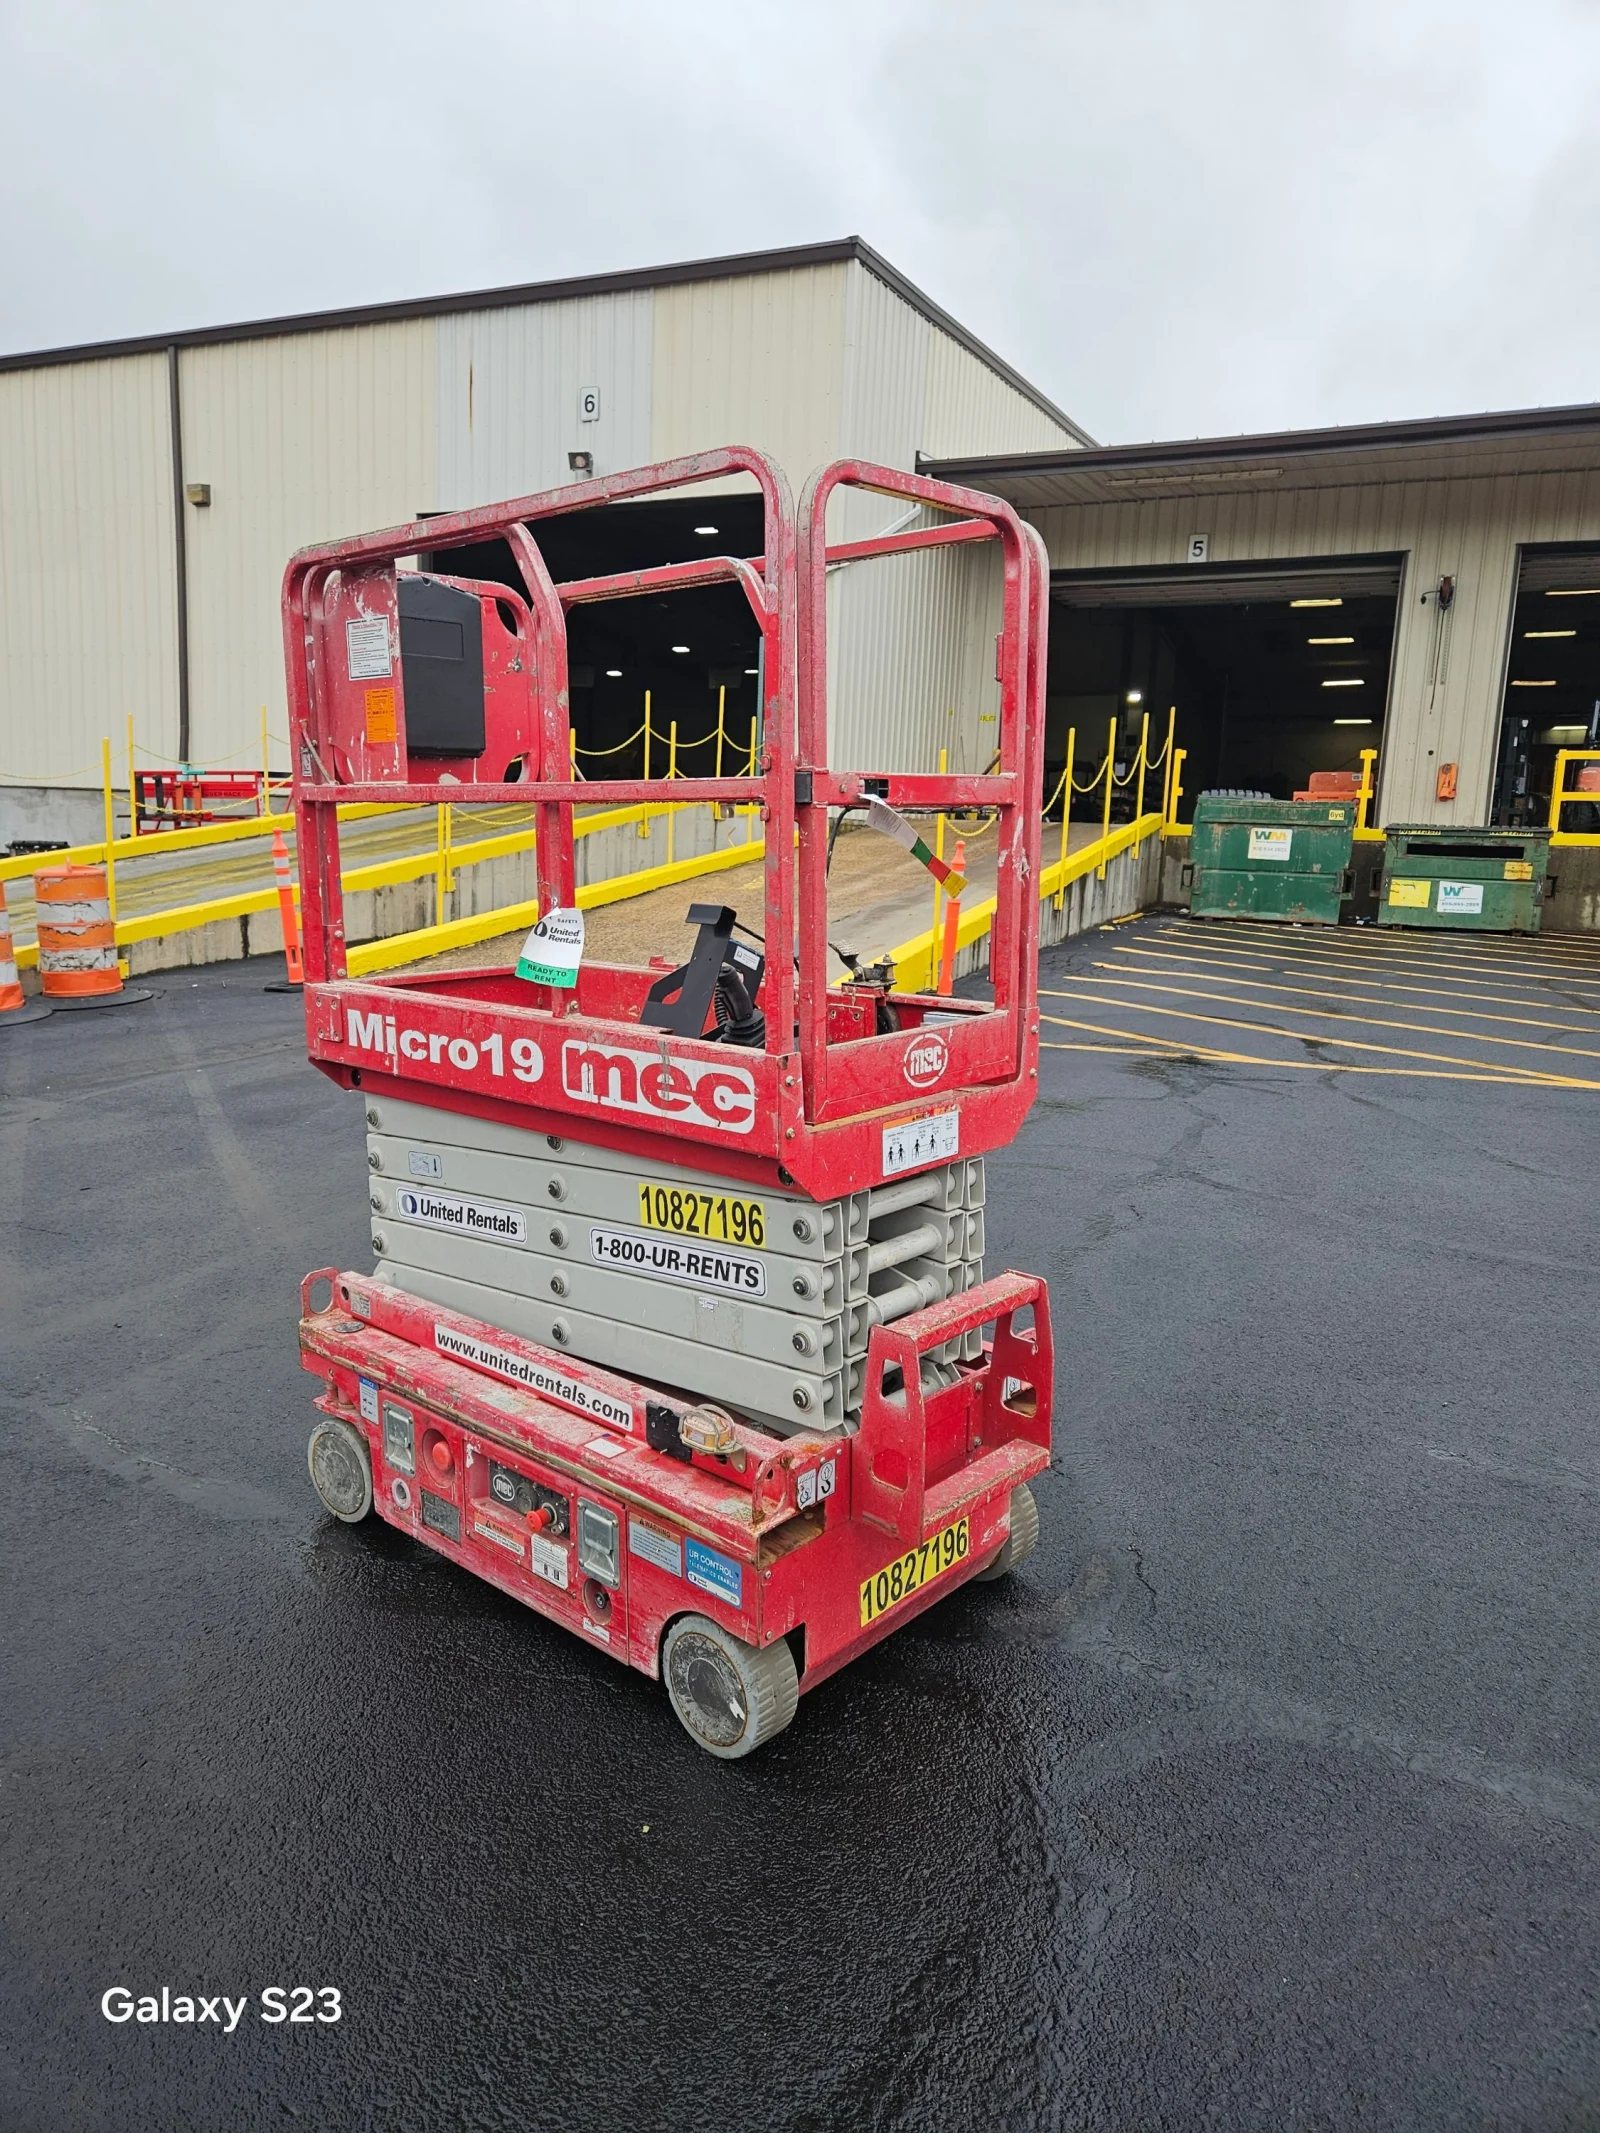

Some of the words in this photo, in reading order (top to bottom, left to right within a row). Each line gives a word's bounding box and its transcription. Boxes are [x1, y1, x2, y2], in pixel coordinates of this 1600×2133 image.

[584, 394, 595, 413] 6
[1191, 540, 1204, 557] 5
[548, 934, 581, 945] Rentals
[550, 926, 580, 937] United
[527, 963, 555, 976] READY
[556, 970, 567, 978] TO
[534, 974, 556, 985] RENT
[346, 1008, 544, 1083] Micro19
[420, 1198, 463, 1225] United
[466, 1208, 518, 1236] Rentals
[640, 1185, 763, 1246] 10827196
[595, 1236, 760, 1288] 1-800-UR-RENTS
[437, 1332, 630, 1427] www.unitedrentals.com
[644, 1520, 671, 1539] WARNING
[688, 1548, 699, 1561] UR
[700, 1554, 734, 1579] CONTROL
[862, 1519, 968, 1620] 10827196
